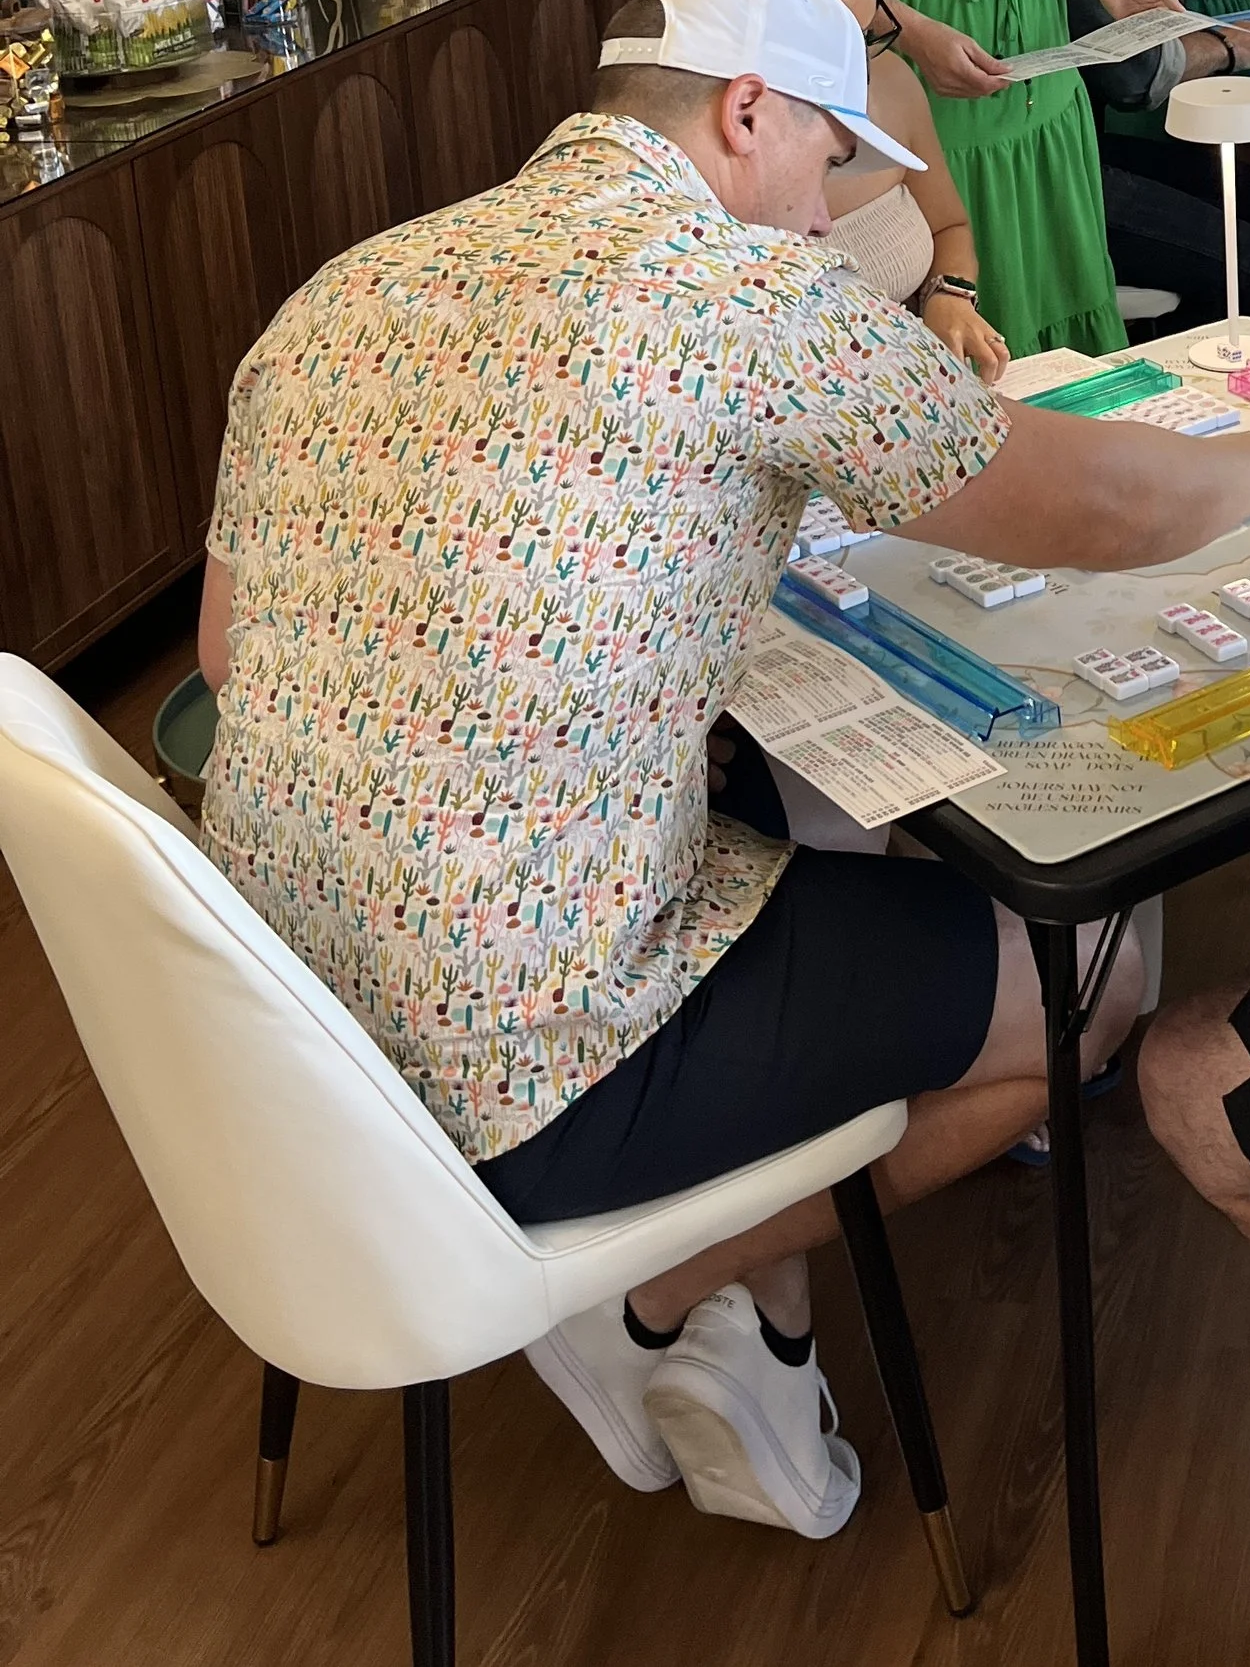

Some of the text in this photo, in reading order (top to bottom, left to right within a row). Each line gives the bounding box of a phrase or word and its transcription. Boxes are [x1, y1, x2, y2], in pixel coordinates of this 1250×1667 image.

[997, 740, 1105, 750] RED DRAGON
[991, 750, 1122, 762] GREEN DRAGON
[1025, 762, 1135, 772] SOAP DOTS
[996, 781, 1147, 794] JOKERS MAY NOT
[1020, 793, 1115, 803] BE USED IN
[985, 803, 1143, 815] SINGLES OR PAIRS
